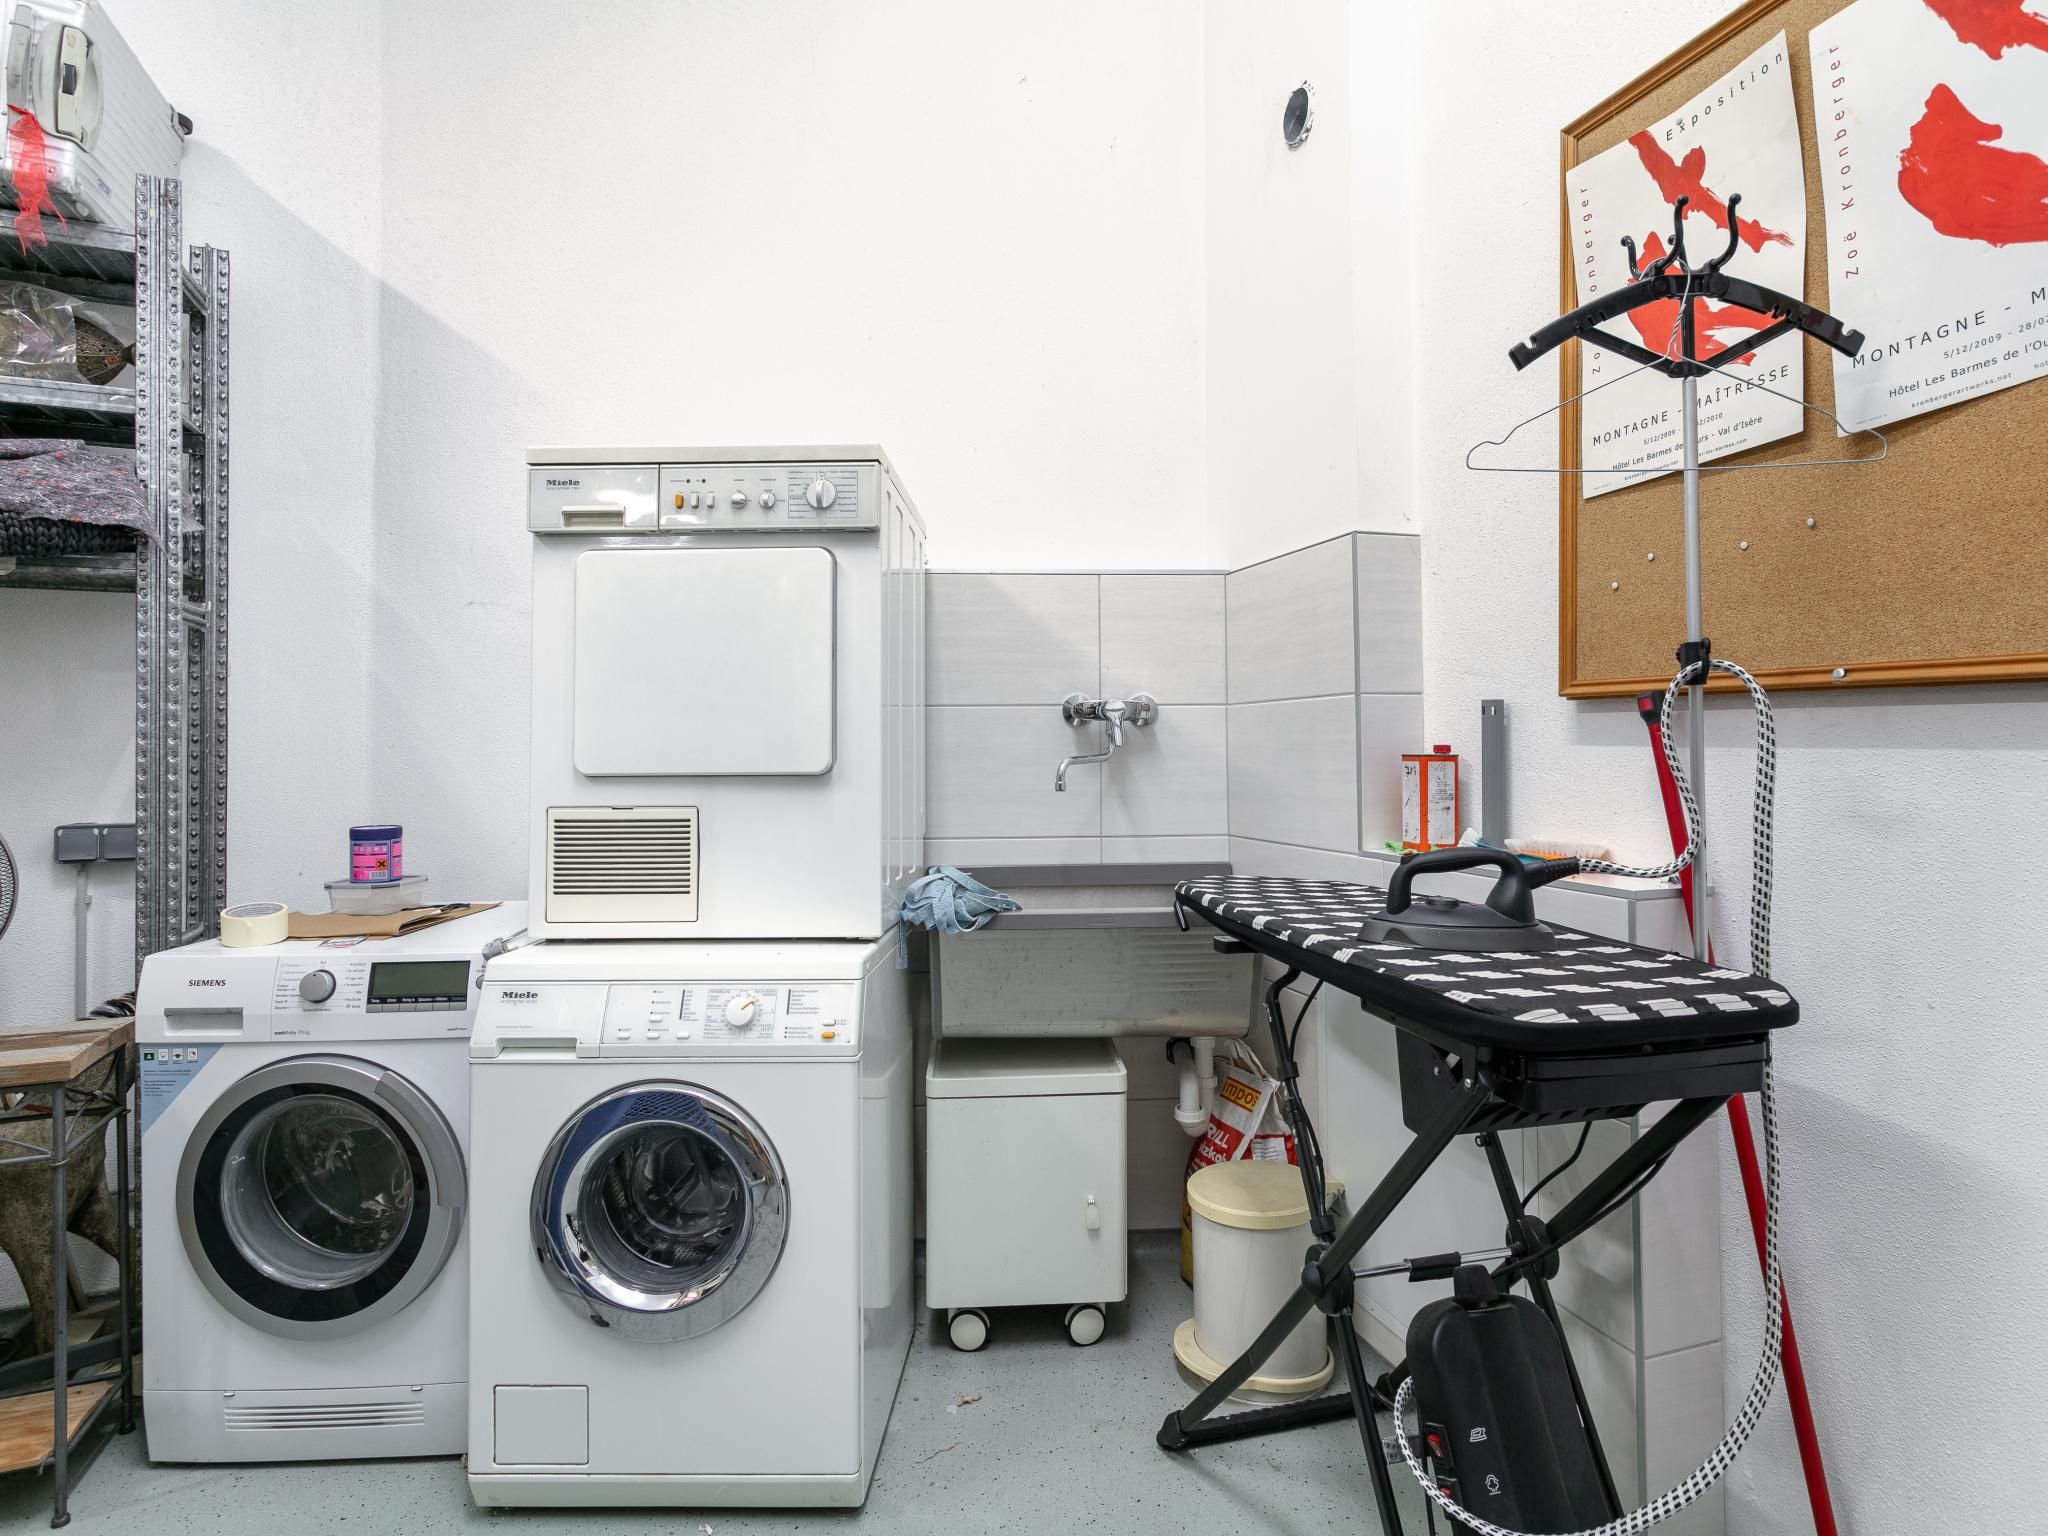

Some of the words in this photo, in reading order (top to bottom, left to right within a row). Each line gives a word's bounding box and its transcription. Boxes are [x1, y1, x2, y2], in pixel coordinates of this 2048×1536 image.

[1666, 53, 1782, 141] Exposition
[1828, 45, 1854, 211] Kronberger
[1580, 187, 1598, 293] onberger
[1843, 230, 1860, 279] Zoë
[1852, 310, 1986, 369] MONTAGNE
[1943, 332, 2002, 360] 5/12/2009
[1889, 380, 1920, 399] Hôtel
[1925, 373, 1946, 387] Les
[1951, 356, 1998, 379] Barmes
[2003, 349, 2019, 362] de
[1592, 409, 1669, 447] MONTAGNE
[1612, 457, 1631, 472] Hôtel
[1632, 455, 1645, 466] Les
[1647, 445, 1673, 461] Barmes
[1718, 425, 1731, 437] Val
[546, 479, 580, 487] Miele
[187, 978, 227, 988] SIEMENS
[500, 991, 538, 999] Miele
[1207, 1125, 1230, 1149] RILL
